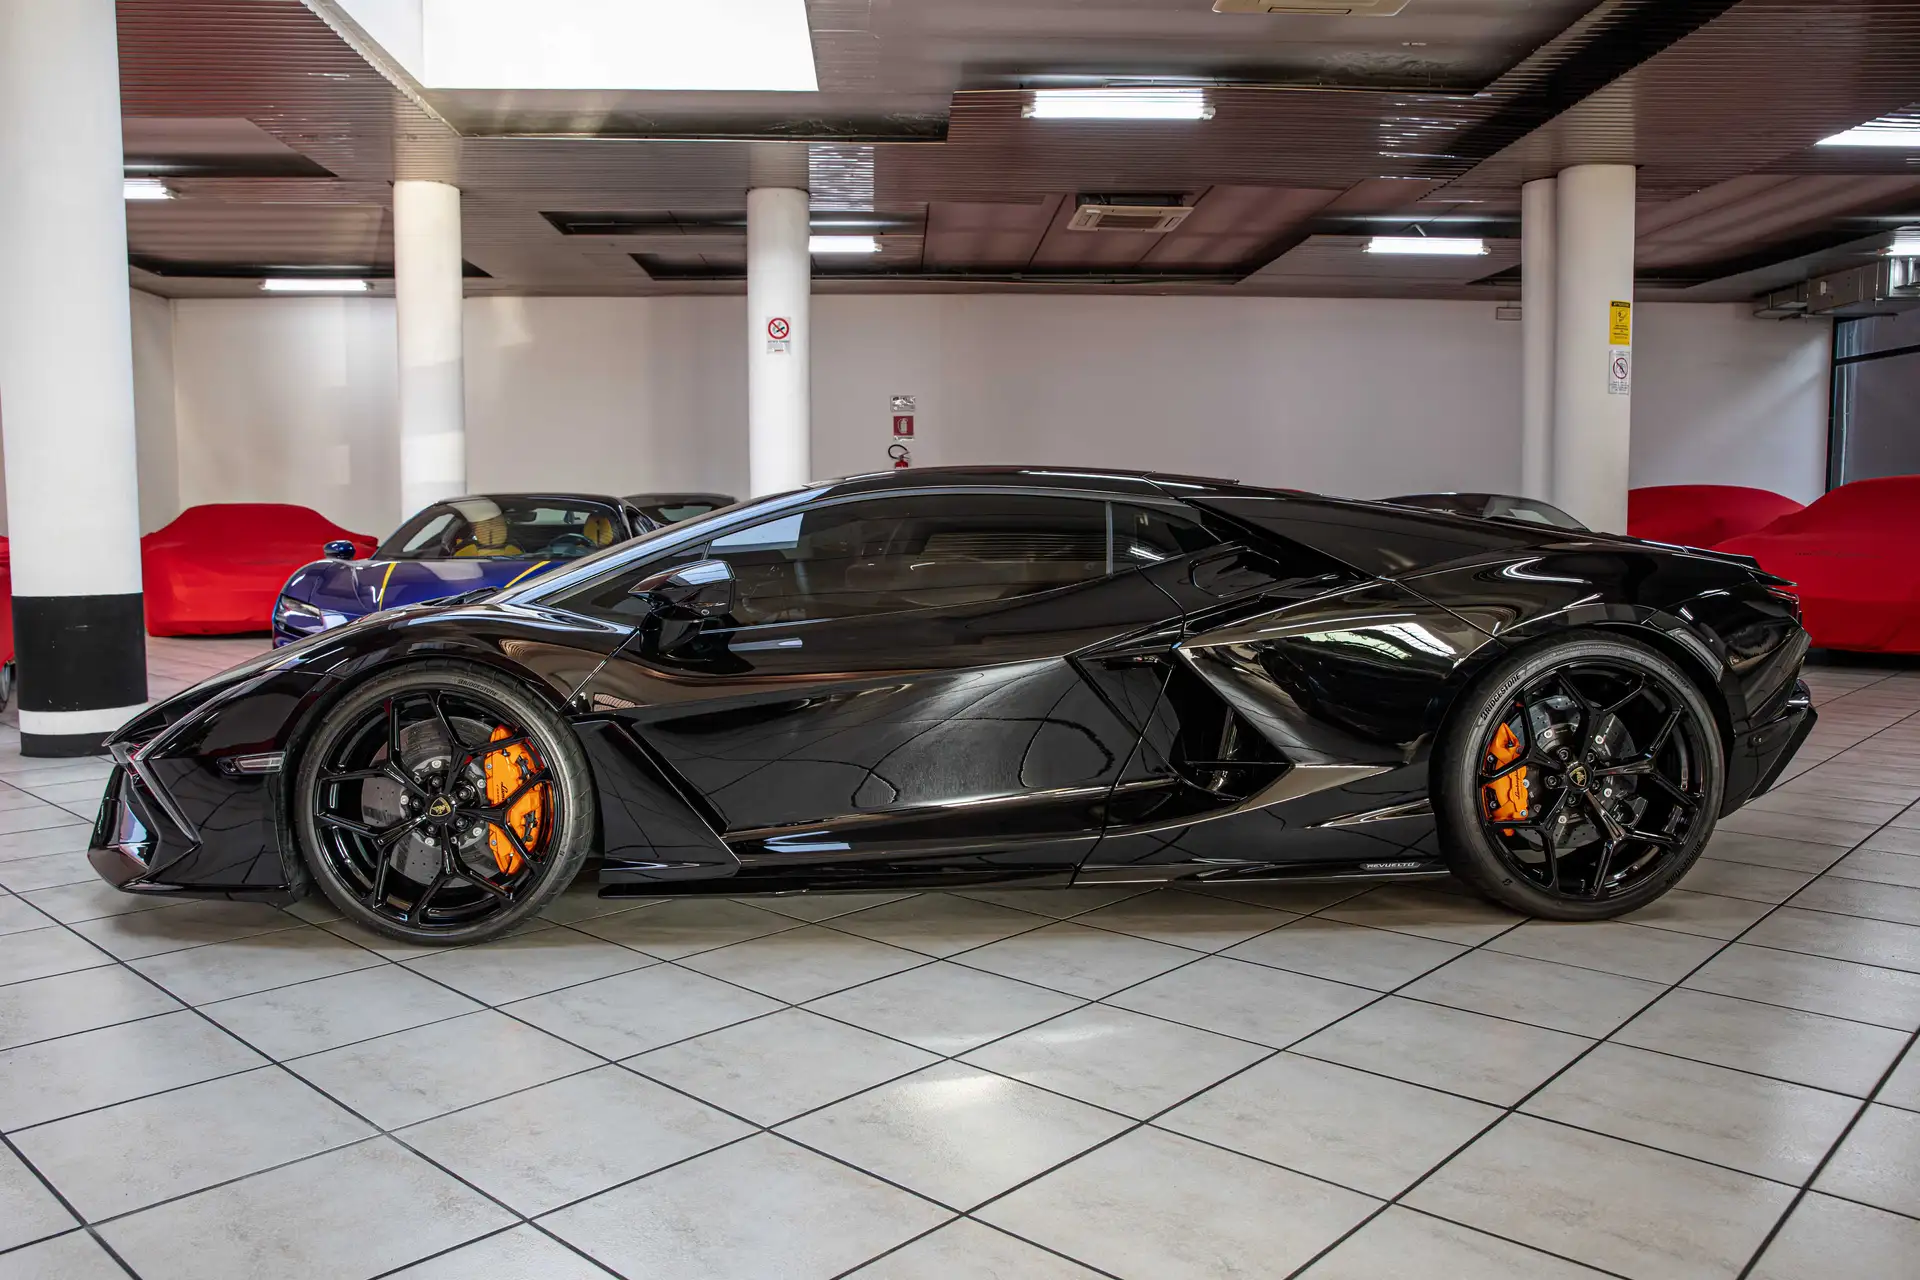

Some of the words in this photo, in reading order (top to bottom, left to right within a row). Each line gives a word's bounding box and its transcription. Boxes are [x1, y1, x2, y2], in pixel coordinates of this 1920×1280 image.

[457, 679, 498, 697] BRIDGESTONE
[1480, 673, 1521, 721] BRIDGESTONE
[1365, 861, 1416, 869] REVUELTO
